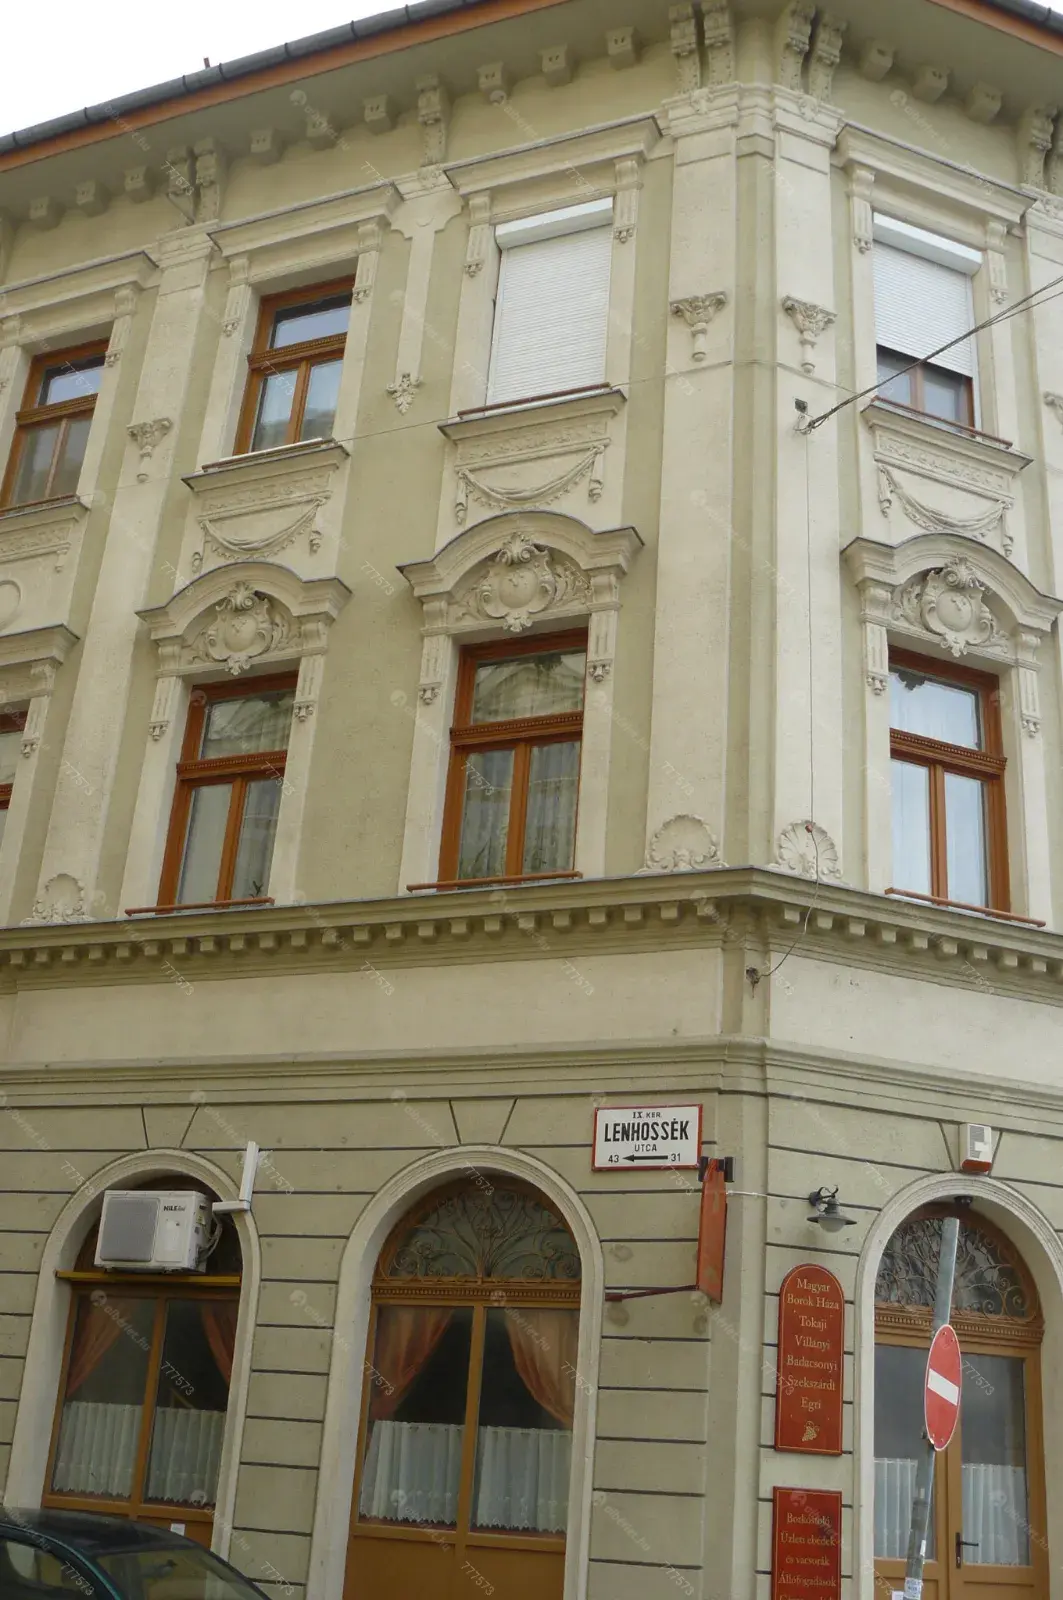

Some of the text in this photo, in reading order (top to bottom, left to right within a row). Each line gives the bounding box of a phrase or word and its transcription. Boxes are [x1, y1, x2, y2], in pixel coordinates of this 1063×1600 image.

[604, 1118, 690, 1142] LENHOSSÉK
[634, 1144, 658, 1152] UTCA
[608, 1153, 681, 1164] 43 31
[796, 1278, 830, 1294] Magyar
[787, 1294, 840, 1310] Borok Háza
[799, 1316, 827, 1332] Tokaji
[786, 1354, 838, 1372] Badacsonyi
[801, 1396, 822, 1412] Egri
